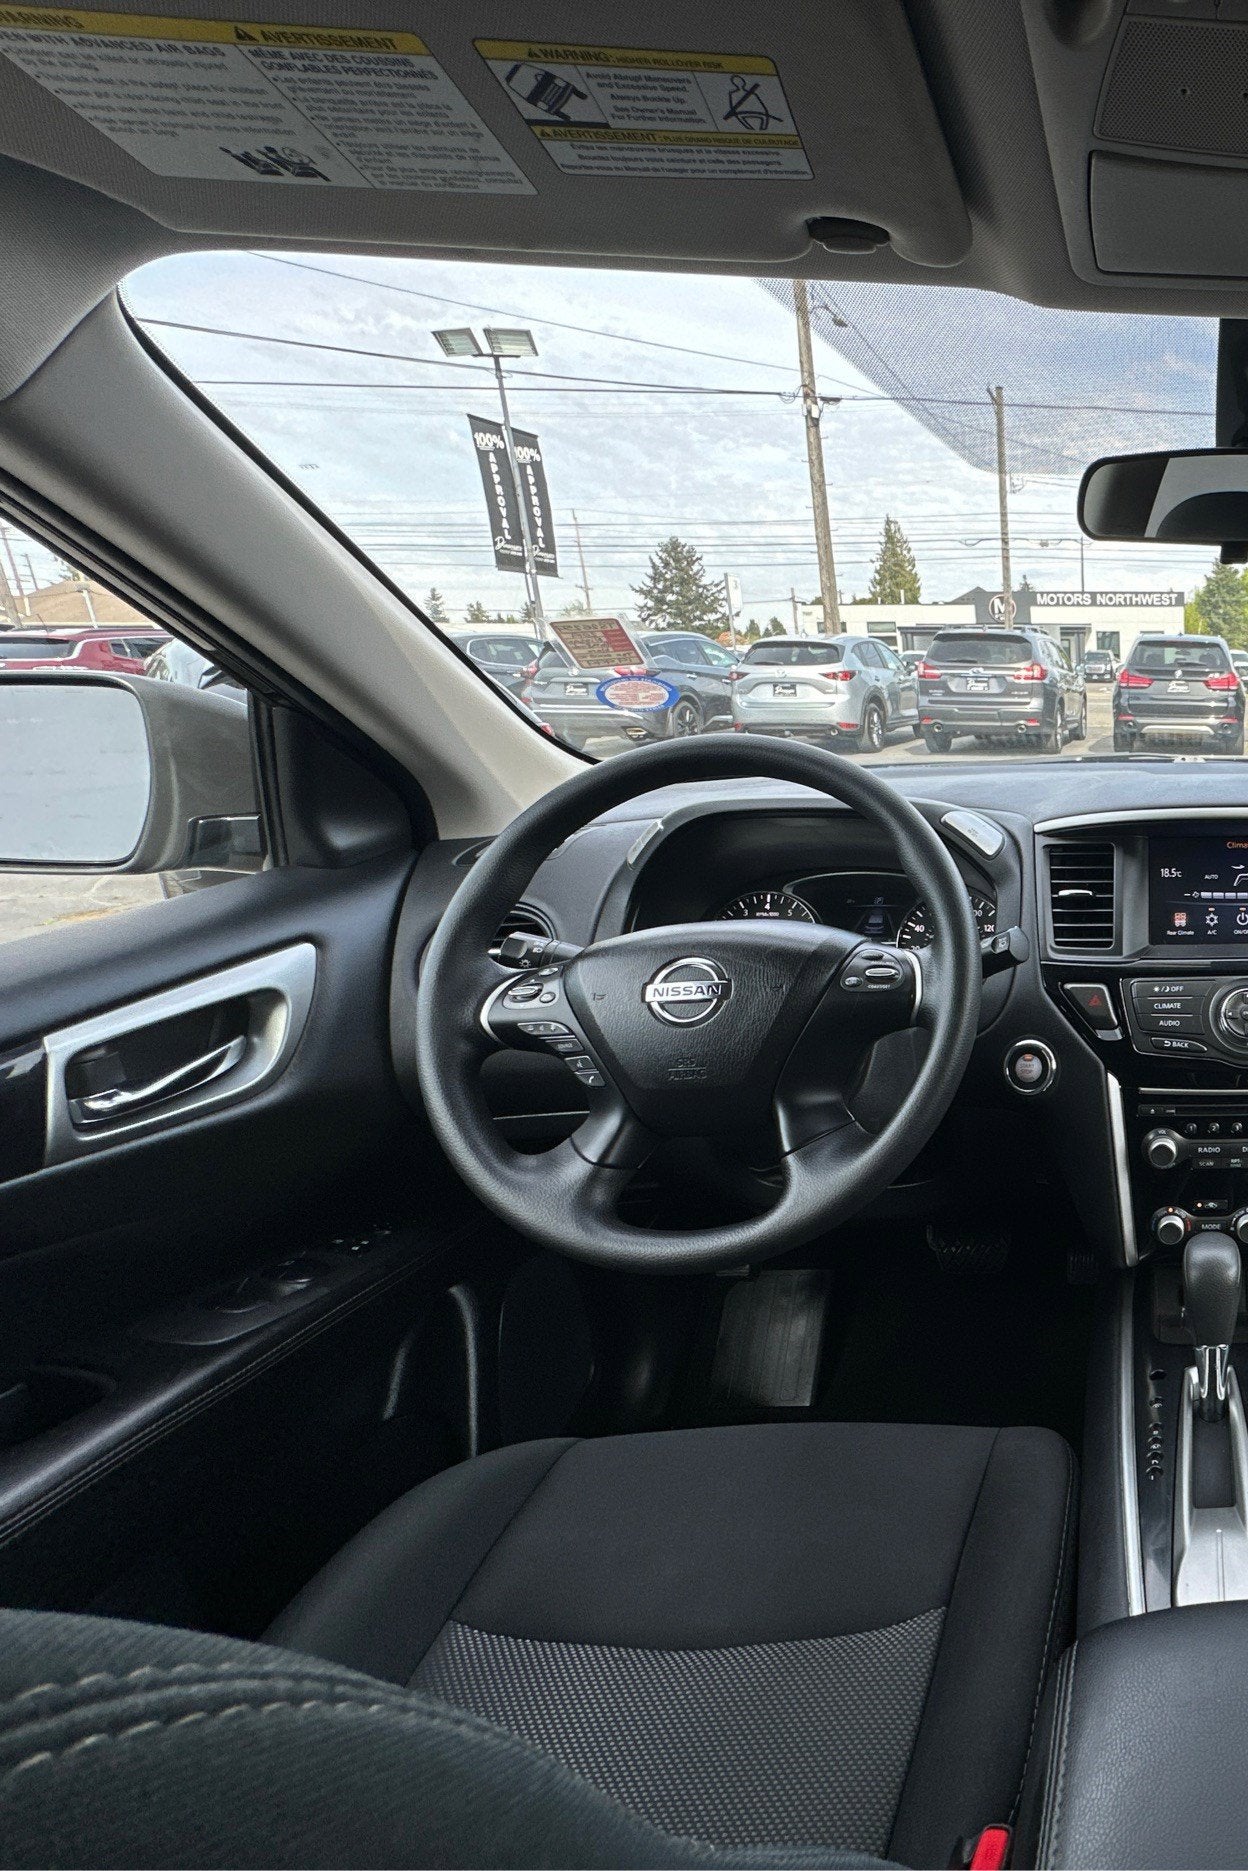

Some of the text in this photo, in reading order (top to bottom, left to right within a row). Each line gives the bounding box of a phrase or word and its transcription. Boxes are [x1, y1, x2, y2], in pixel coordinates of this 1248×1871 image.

[260, 29, 399, 51] AVERTISSEMENT
[71, 36, 155, 53] ADVANCED
[156, 44, 184, 55] AIR
[182, 45, 227, 58] BAGS
[290, 50, 326, 63] AVEC
[327, 53, 352, 65] DES
[351, 55, 416, 69] COUSSINS
[652, 57, 703, 69] ROLLOVER
[610, 93, 641, 103] Always
[665, 107, 698, 116] Manual
[551, 129, 657, 144] AVERTISSEMENT
[474, 431, 506, 450] 100%
[514, 445, 541, 463] 100%
[488, 451, 512, 541] APPROVAL
[526, 463, 546, 549] APPROVAL
[1036, 592, 1179, 607] MOTORS NORTHWEST
[764, 902, 771, 911] 4
[743, 909, 749, 917] 3
[787, 909, 793, 917] 5
[914, 925, 925, 933] 40
[1177, 929, 1195, 937] Climate
[653, 985, 721, 998] NISSAN
[1170, 985, 1184, 993] OFF
[1153, 1002, 1181, 1010] CLIMATE
[1158, 1020, 1180, 1028] AUDIO
[1171, 1040, 1190, 1049] BACK
[1198, 1146, 1221, 1154] RADIO
